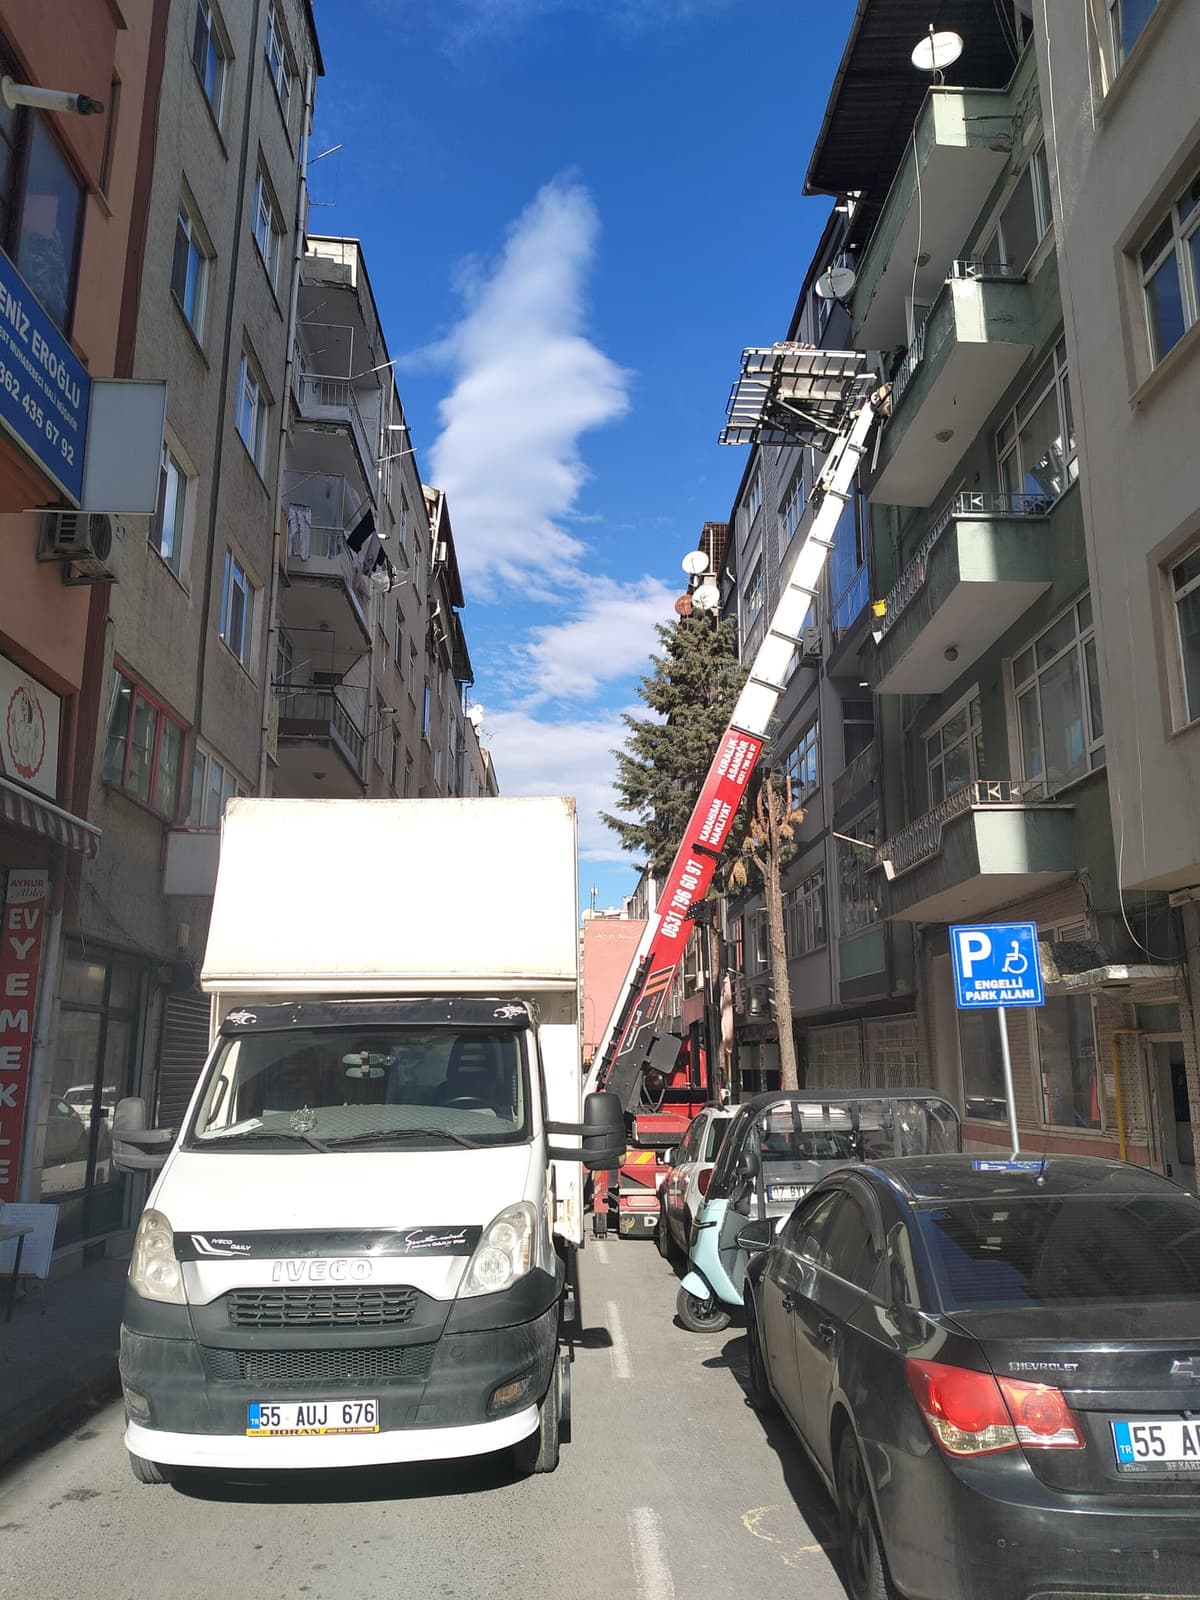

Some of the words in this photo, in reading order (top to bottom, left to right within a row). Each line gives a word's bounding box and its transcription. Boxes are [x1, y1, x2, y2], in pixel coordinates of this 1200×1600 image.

[31, 328, 80, 408] EROĞLU
[22, 394, 43, 428] 435
[46, 420, 59, 446] 67
[61, 438, 74, 466] 92
[716, 738, 739, 776] KIRALIK
[685, 858, 704, 876] 97
[10, 879, 44, 888] AYNUR
[680, 873, 698, 890] 60
[671, 888, 692, 911] 796
[9, 907, 39, 930] EV
[660, 910, 684, 938] 0531
[958, 931, 992, 978] P
[965, 990, 998, 1001] PARK
[999, 988, 1035, 1000] ALANI
[974, 976, 1023, 990] ENGELLİ
[230, 1243, 252, 1251] DAILY
[271, 1259, 373, 1282] IVECO
[1008, 1361, 1079, 1372] CHEVROLET
[260, 1406, 281, 1427] 55
[296, 1404, 328, 1427] AUJ
[342, 1403, 375, 1425] 676
[1119, 1444, 1132, 1455] TR
[1132, 1425, 1166, 1457] 55
